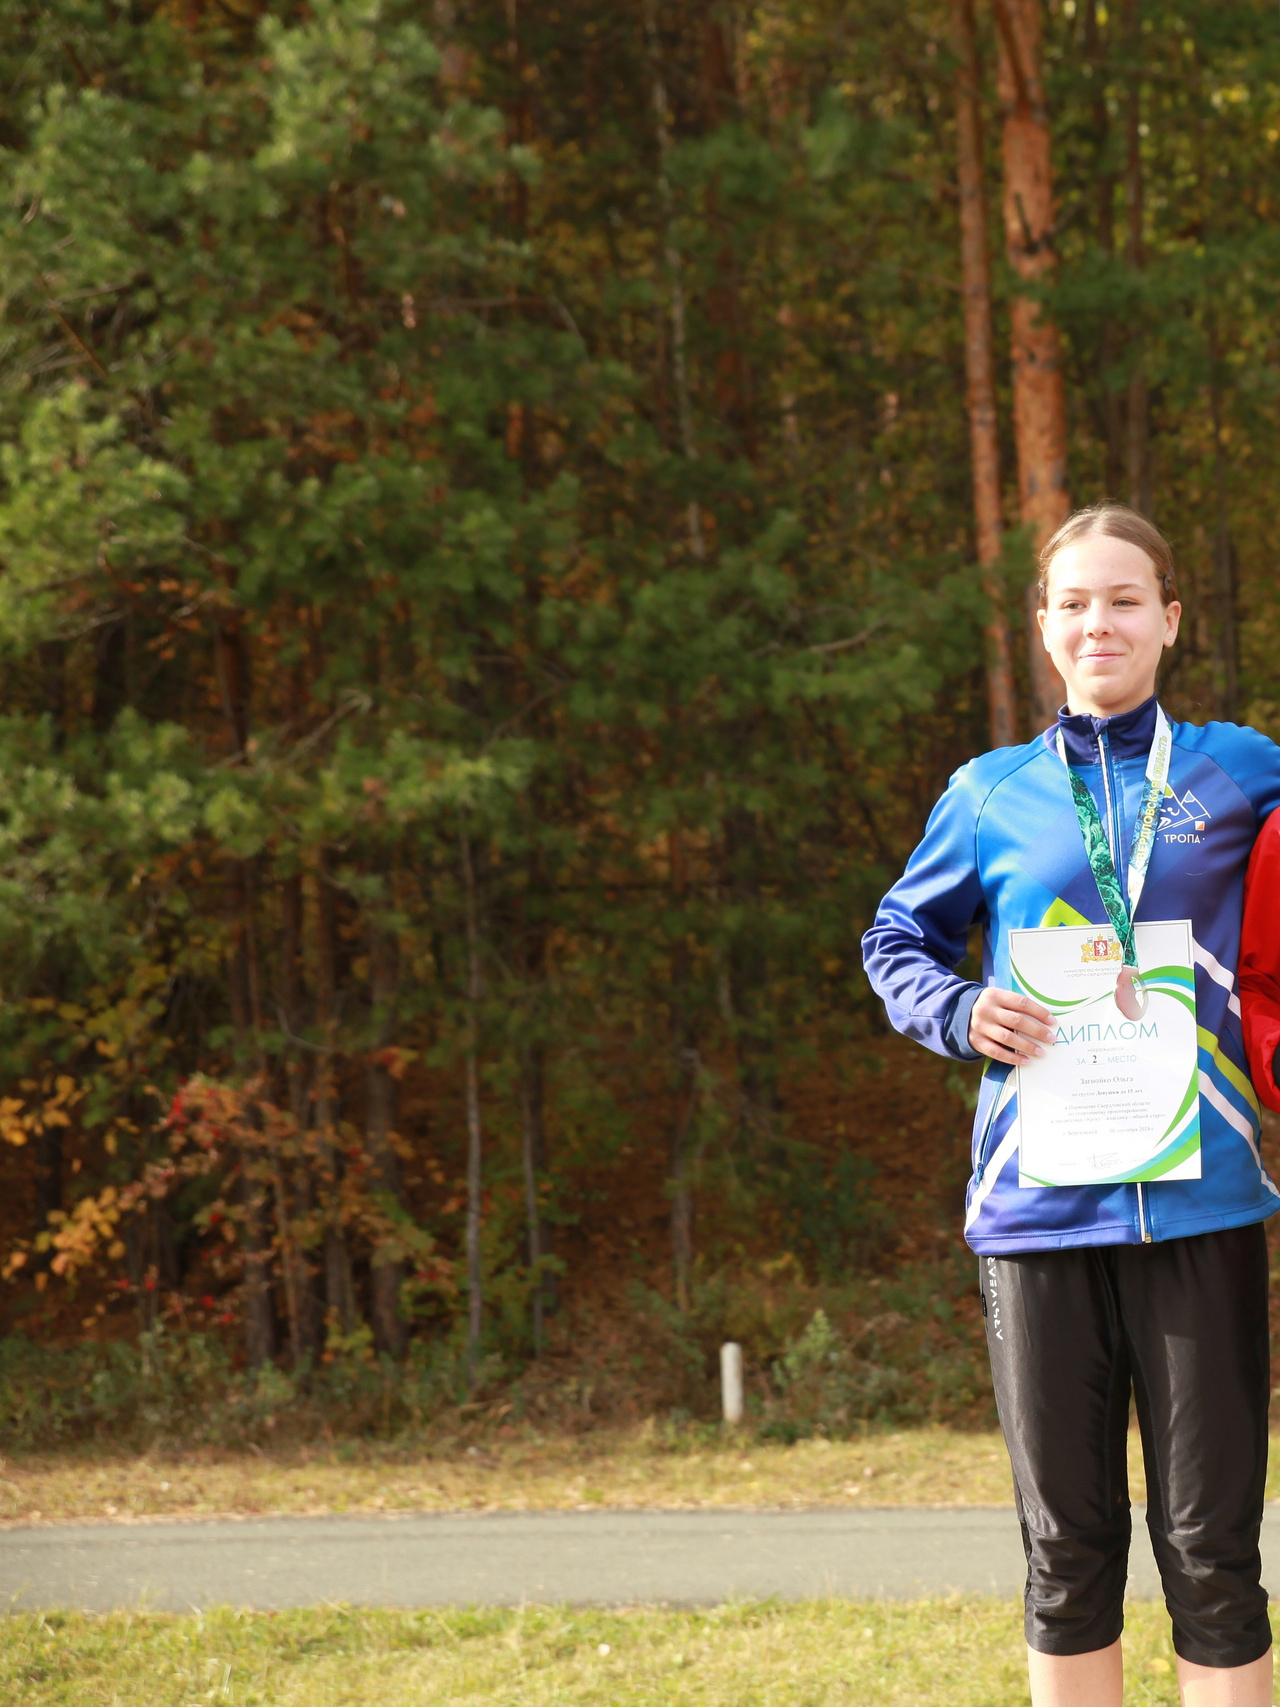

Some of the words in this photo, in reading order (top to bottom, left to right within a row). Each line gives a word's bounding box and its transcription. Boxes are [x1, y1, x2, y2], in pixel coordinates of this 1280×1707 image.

[1153, 734, 1168, 780] ОБЛАСТЬ
[1164, 834, 1201, 844] ТРОПА
[1052, 1022, 1159, 1046] ДИПЛОМ
[1092, 1055, 1098, 1064] 2
[1107, 1055, 1137, 1064] МЕСТО
[1112, 1076, 1134, 1084] Ольга
